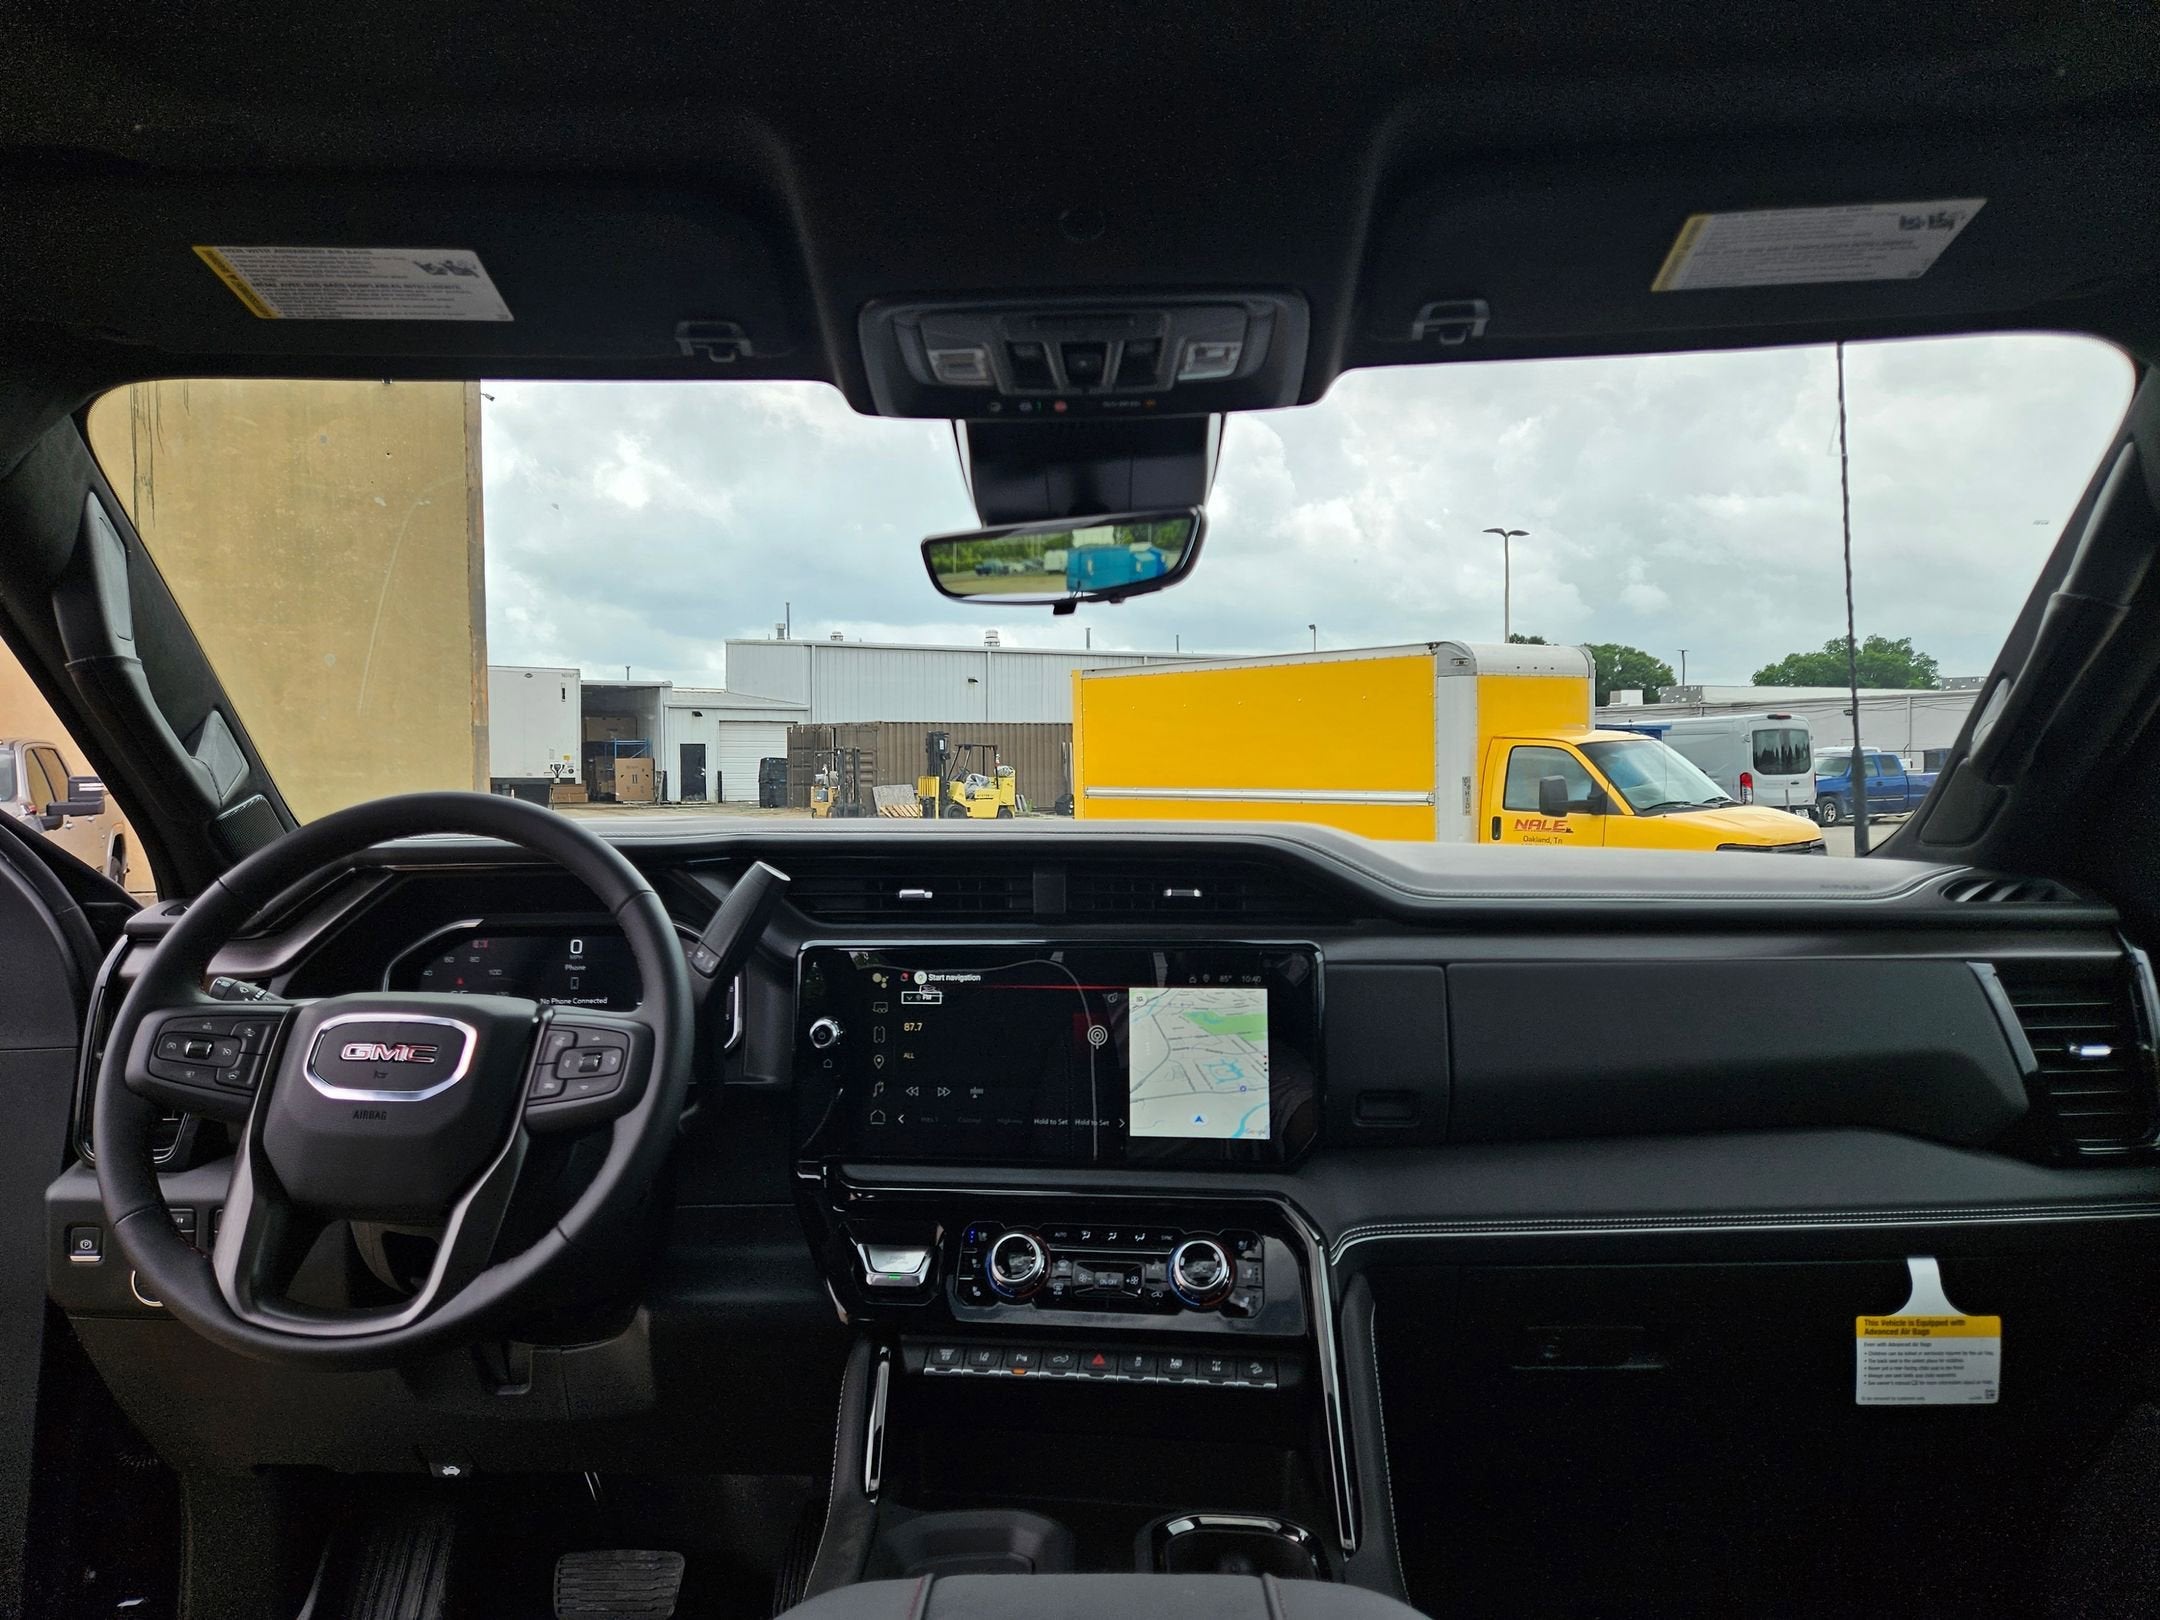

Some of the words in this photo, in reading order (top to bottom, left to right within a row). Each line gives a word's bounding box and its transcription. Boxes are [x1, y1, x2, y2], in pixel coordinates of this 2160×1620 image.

[1514, 819, 1569, 831] NALE
[1523, 835, 1552, 845] Oakland,
[1554, 837, 1563, 845] Tn
[570, 939, 583, 954] 0
[928, 973, 945, 981] Start
[945, 973, 981, 983] navigation
[551, 997, 571, 1005] Phone
[903, 1022, 923, 1032] 87.7
[341, 1043, 438, 1064] GMC
[353, 1110, 387, 1120] AIRBAG
[1058, 1118, 1068, 1126] Set
[1099, 1119, 1110, 1127] Set
[1864, 1319, 1879, 1327] This
[1881, 1319, 1907, 1327] Vehicle
[1909, 1319, 1914, 1327] is
[1916, 1319, 1949, 1328] Equipped
[1951, 1319, 1966, 1327] with
[1864, 1328, 1899, 1336] Advanced
[1901, 1328, 1910, 1336] Air
[1912, 1328, 1930, 1337] Bags
